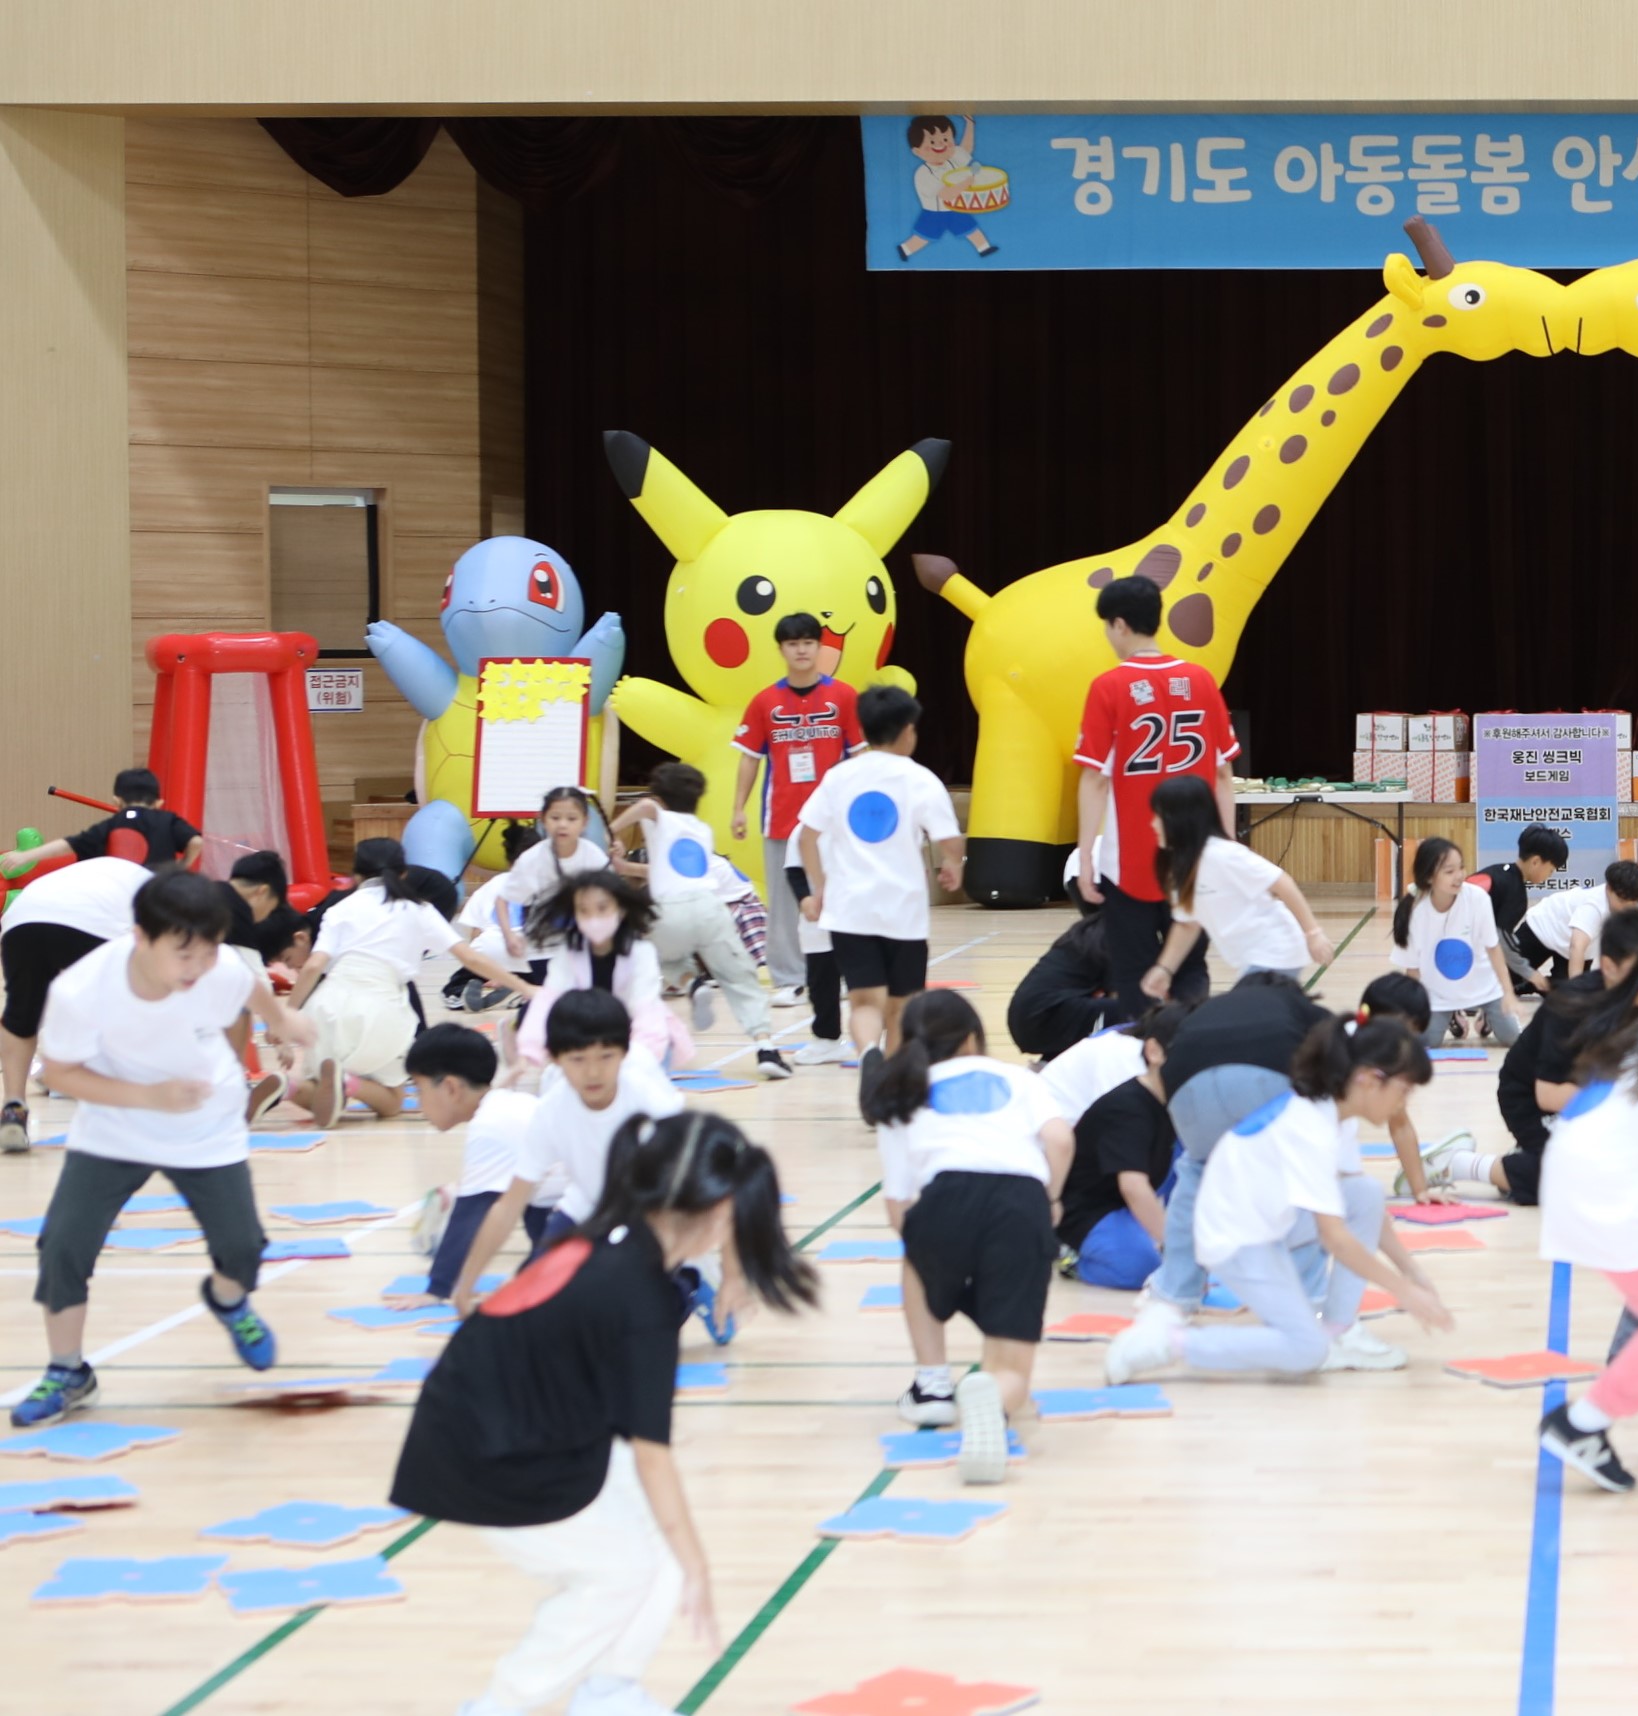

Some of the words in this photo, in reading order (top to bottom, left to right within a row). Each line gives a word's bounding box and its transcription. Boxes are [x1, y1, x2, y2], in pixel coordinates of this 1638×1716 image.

[1050, 134, 1252, 217] 경기도
[1274, 133, 1530, 217] 아동돌봄
[309, 674, 360, 689] 접근금지
[316, 690, 352, 706] (위험)
[1123, 709, 1206, 776] 25
[1512, 750, 1538, 764] 웅진
[1542, 750, 1582, 764] 씽크빅
[1524, 770, 1570, 782] 보드게임
[1484, 807, 1611, 822] 한국재난안전교육협회
